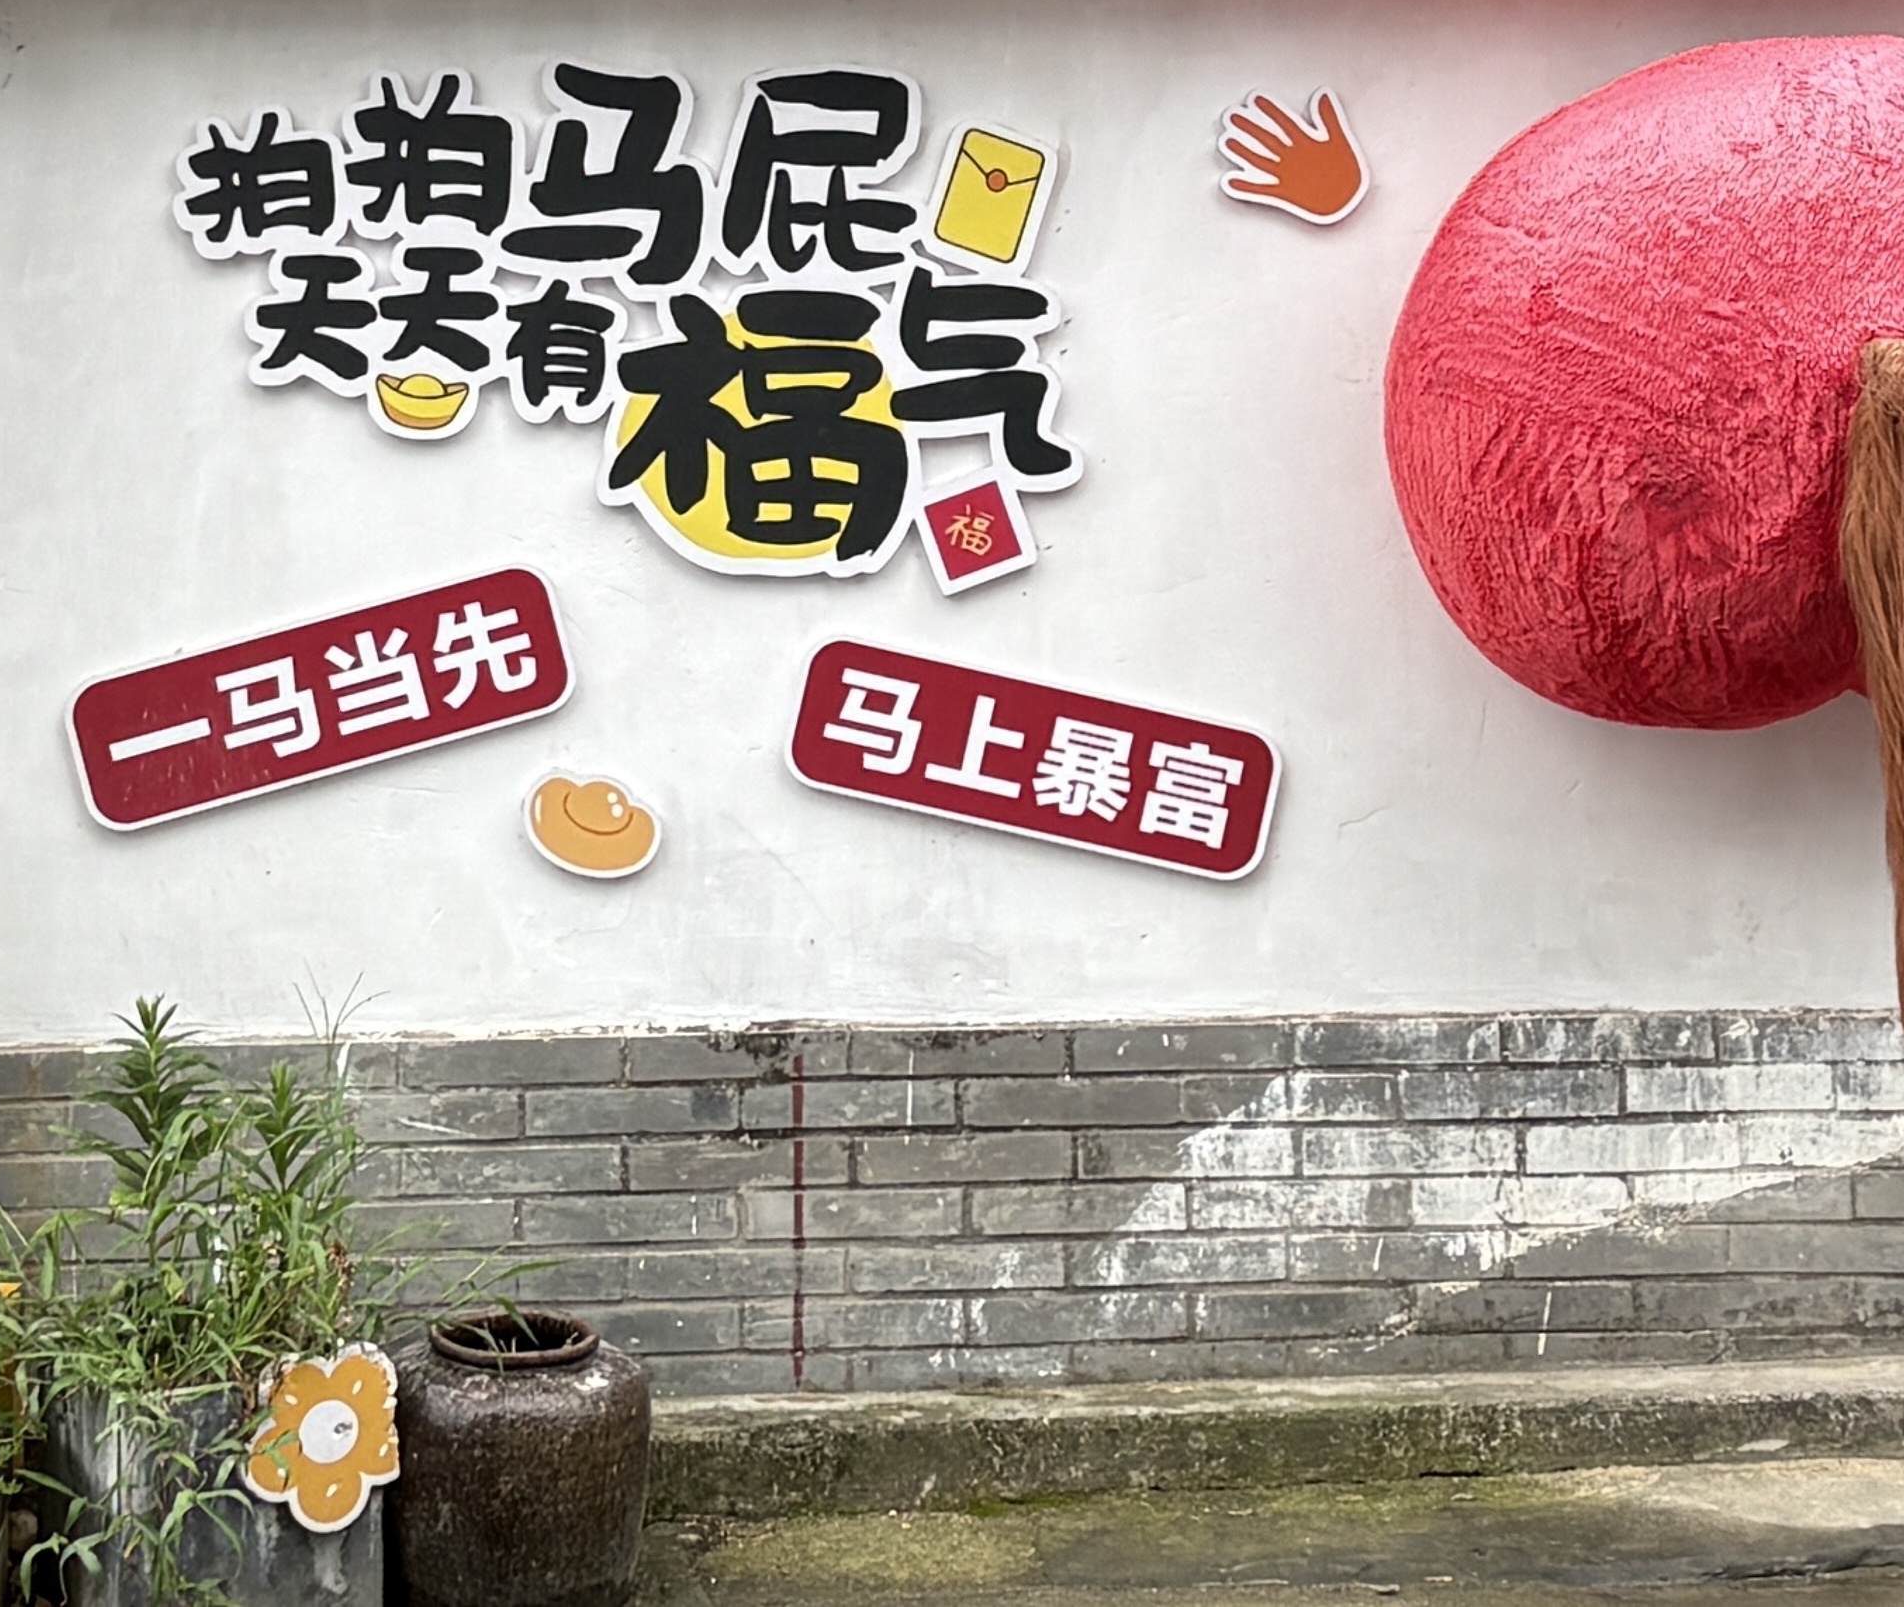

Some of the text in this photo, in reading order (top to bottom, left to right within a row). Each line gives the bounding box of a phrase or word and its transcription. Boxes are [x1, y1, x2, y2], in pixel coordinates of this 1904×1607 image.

[183, 62, 917, 286] 拍拍马屁
[254, 246, 1073, 562] 天天有福气
[945, 504, 995, 556] 福
[109, 602, 538, 762] 一马当先
[824, 668, 1246, 849] 马上暴富
